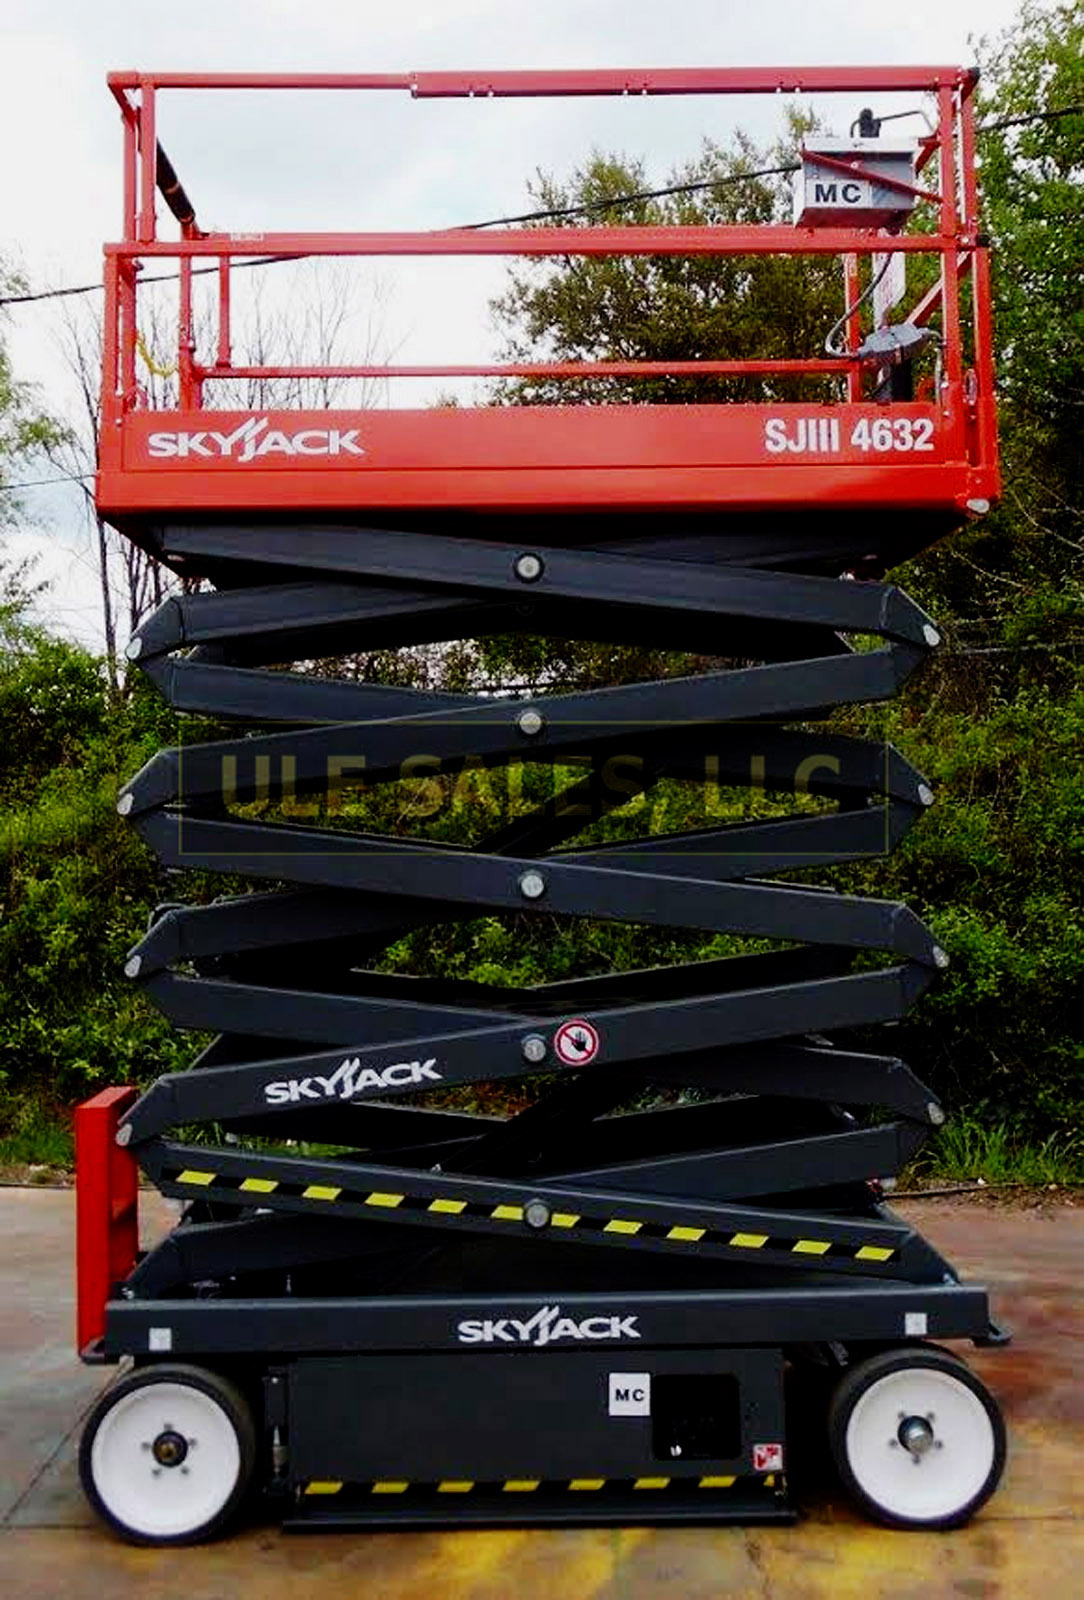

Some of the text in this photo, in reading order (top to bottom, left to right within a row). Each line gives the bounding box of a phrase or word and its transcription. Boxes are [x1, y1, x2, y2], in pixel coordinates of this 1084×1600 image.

[814, 183, 862, 204] MC
[148, 416, 365, 463] SKYJACK
[764, 418, 935, 453] SJIII 4632
[264, 1057, 443, 1104] SKYJACK
[457, 1305, 641, 1347] SKYJACK
[614, 1388, 645, 1402] MC
